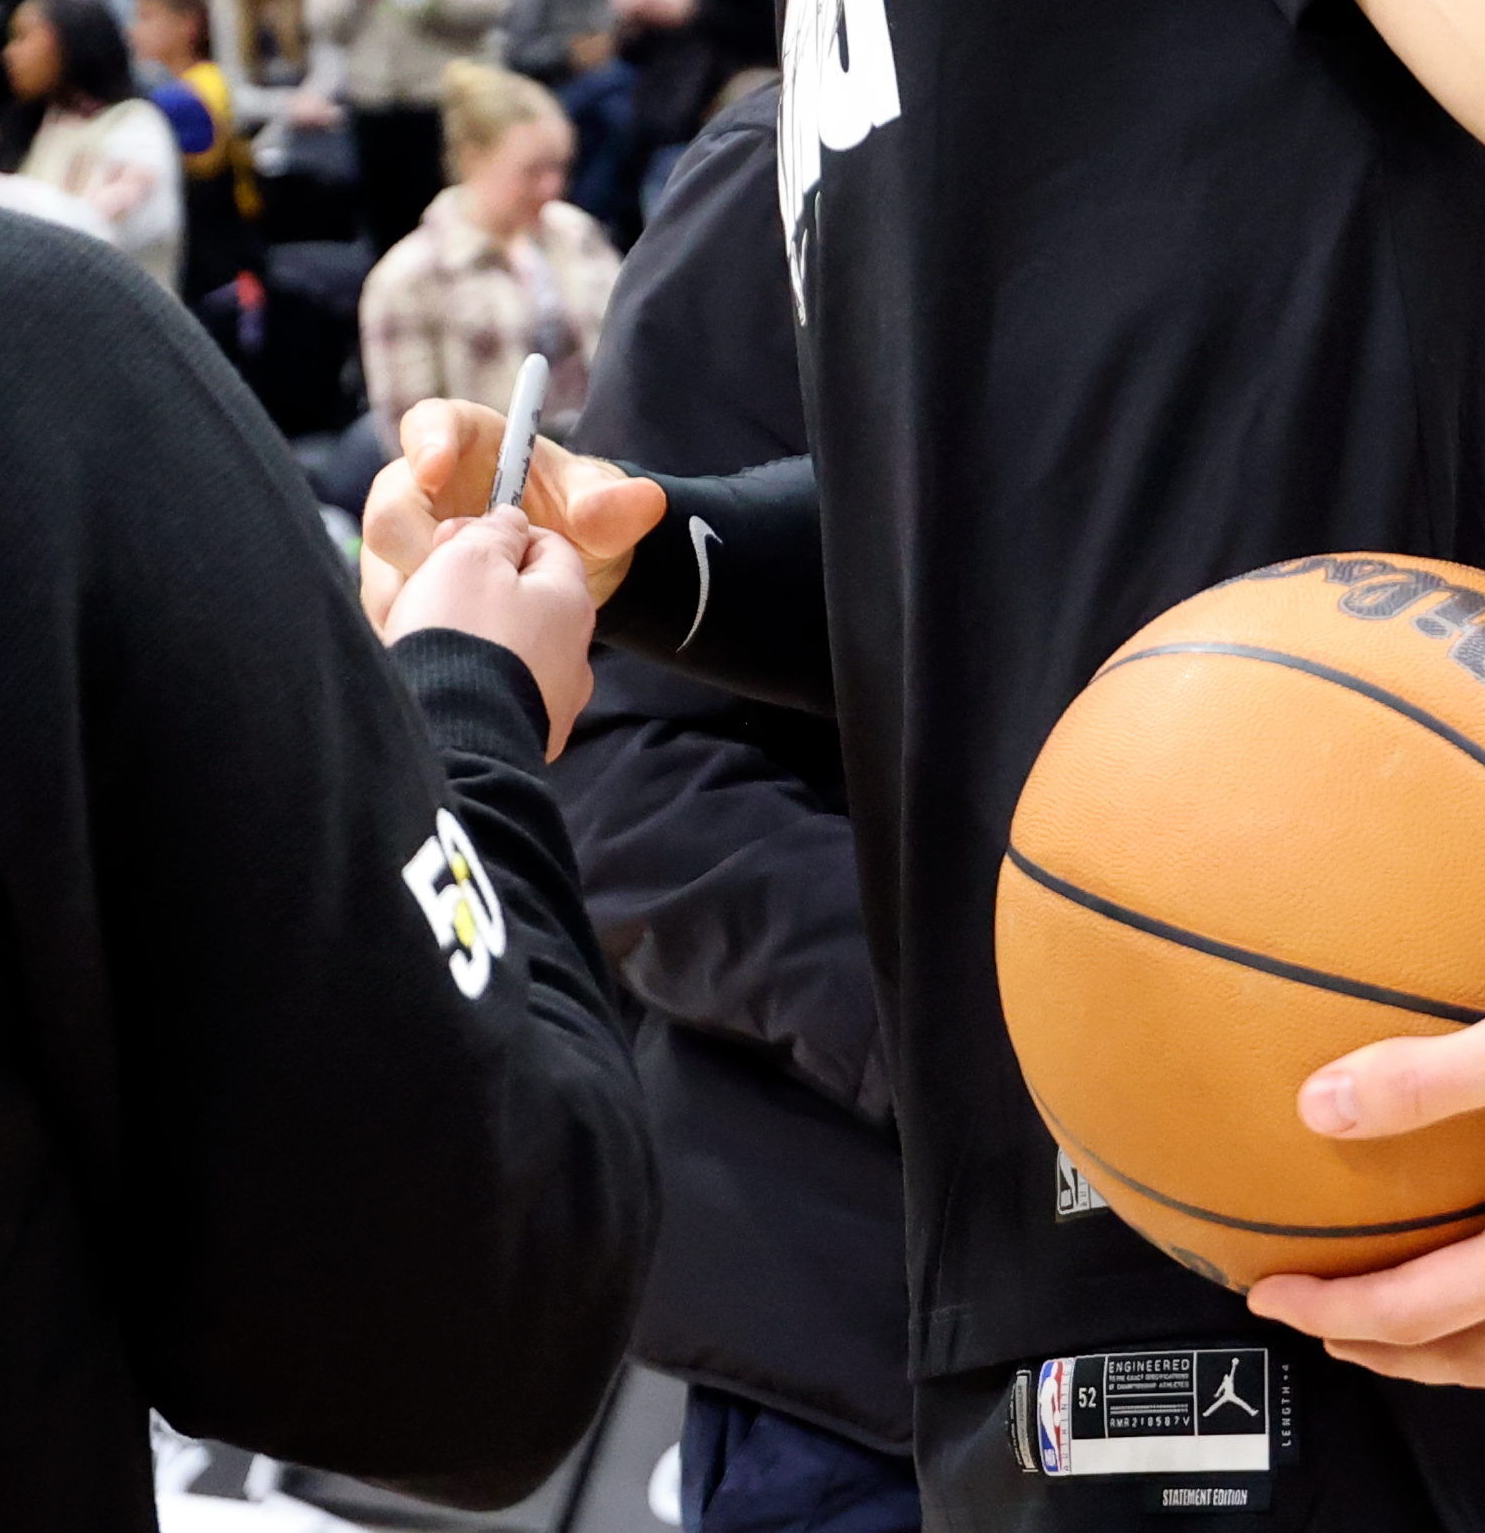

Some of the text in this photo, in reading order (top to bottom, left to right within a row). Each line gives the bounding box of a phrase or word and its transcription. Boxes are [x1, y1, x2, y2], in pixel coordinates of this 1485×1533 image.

[1108, 1358, 1190, 1373] ENGINEERED
[1078, 1387, 1096, 1407] 52
[1281, 1386, 1291, 1447] LENGTH
[1162, 1488, 1247, 1506] STATEMENT EDITION
